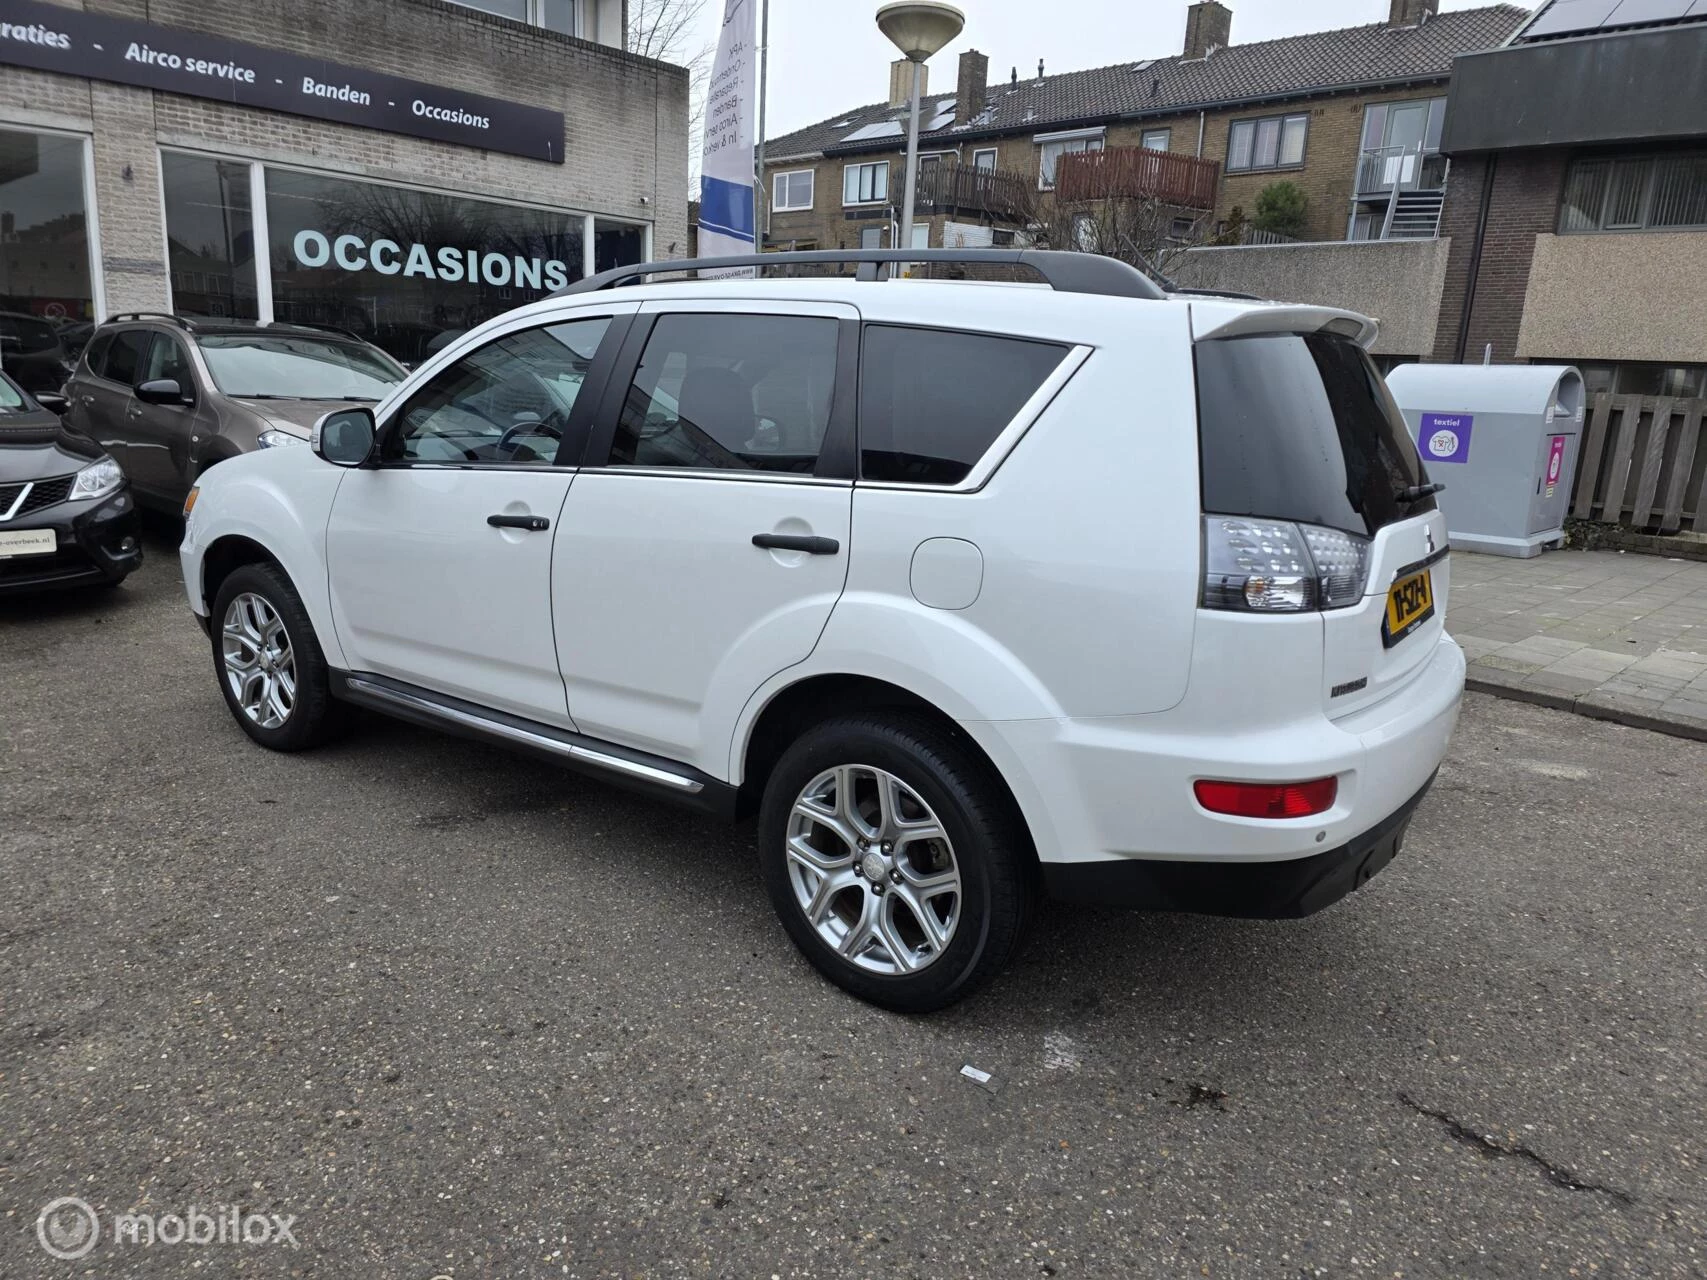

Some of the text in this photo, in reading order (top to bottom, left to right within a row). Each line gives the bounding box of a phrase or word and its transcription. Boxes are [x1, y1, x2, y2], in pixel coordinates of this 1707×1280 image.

[0, 22, 71, 49] raties
[125, 42, 181, 69] Airco
[185, 58, 256, 83] service
[302, 76, 371, 105] Banden
[412, 100, 490, 129] Occasions
[293, 229, 568, 291] OCCASIONS
[1434, 418, 1461, 427] textiel
